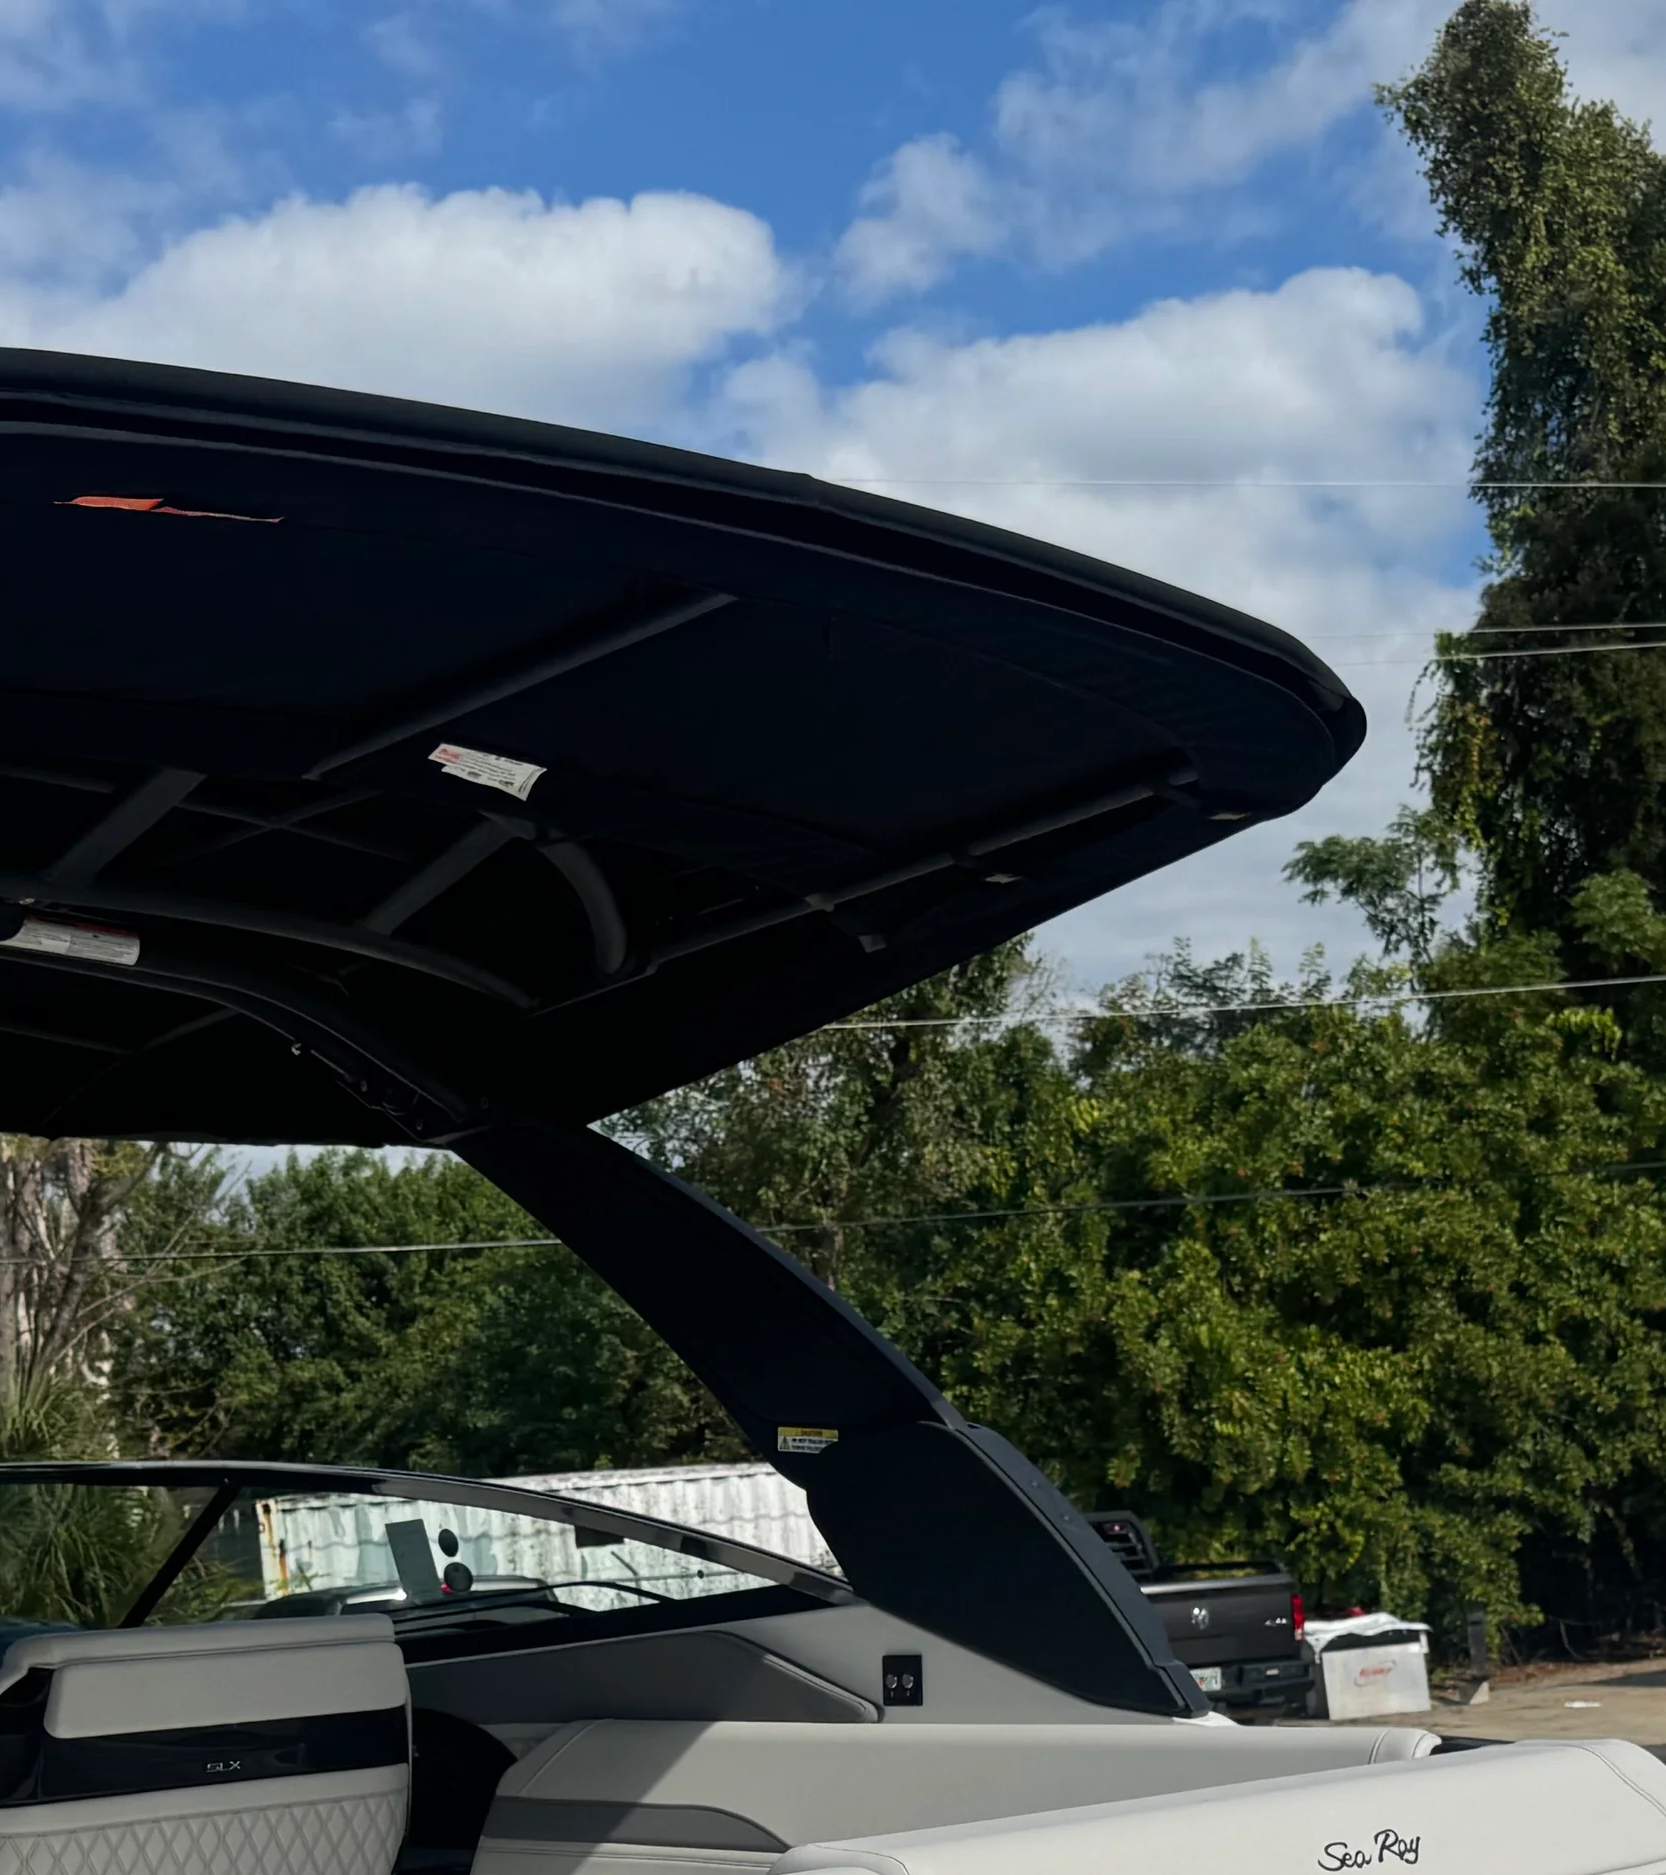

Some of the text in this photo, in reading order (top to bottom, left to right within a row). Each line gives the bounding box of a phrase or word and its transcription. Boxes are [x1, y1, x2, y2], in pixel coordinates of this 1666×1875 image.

[206, 1761, 241, 1773] SLX
[1317, 1828, 1421, 1872] Sea Ray
